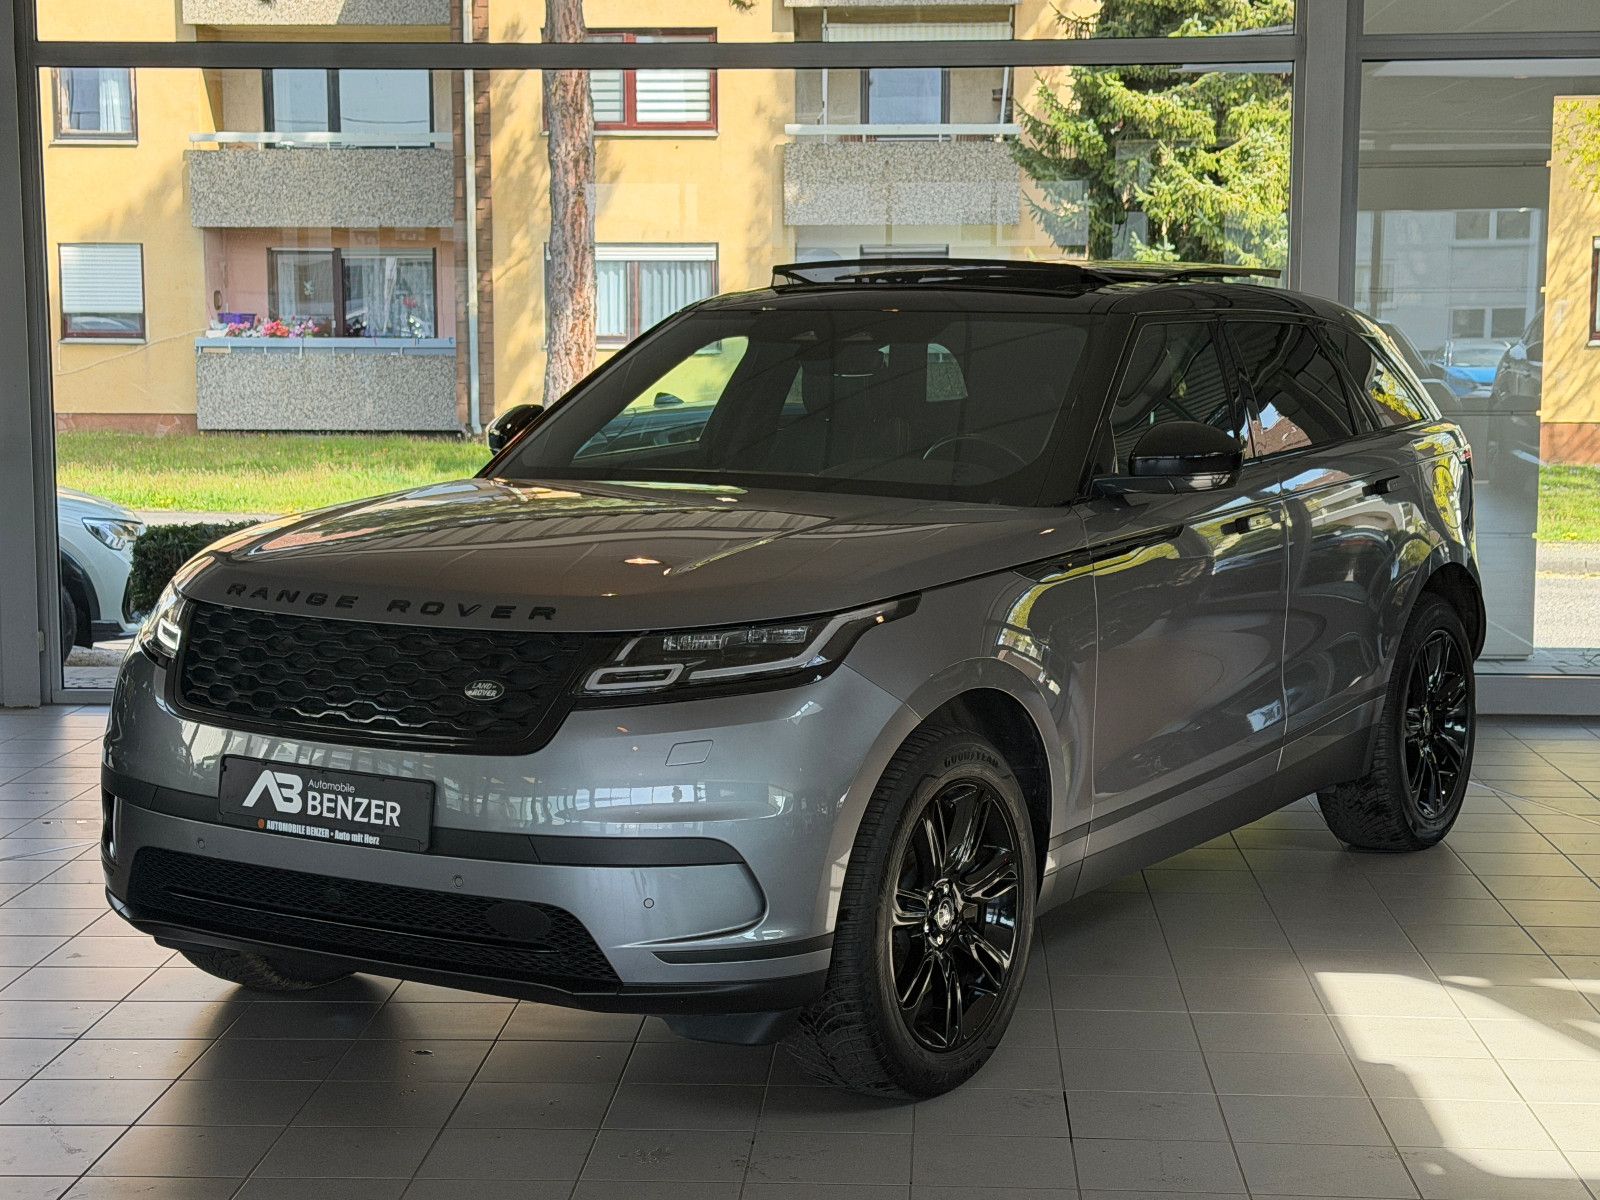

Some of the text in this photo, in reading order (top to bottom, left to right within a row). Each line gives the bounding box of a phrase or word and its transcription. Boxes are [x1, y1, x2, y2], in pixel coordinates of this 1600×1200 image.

[226, 582, 557, 621] RANGE ROVER
[242, 769, 303, 814] AB
[308, 779, 356, 793] Automobile
[306, 790, 401, 827] BENZER
[266, 820, 380, 845] AUTOMOBILE BENZER Auto mit Herz
